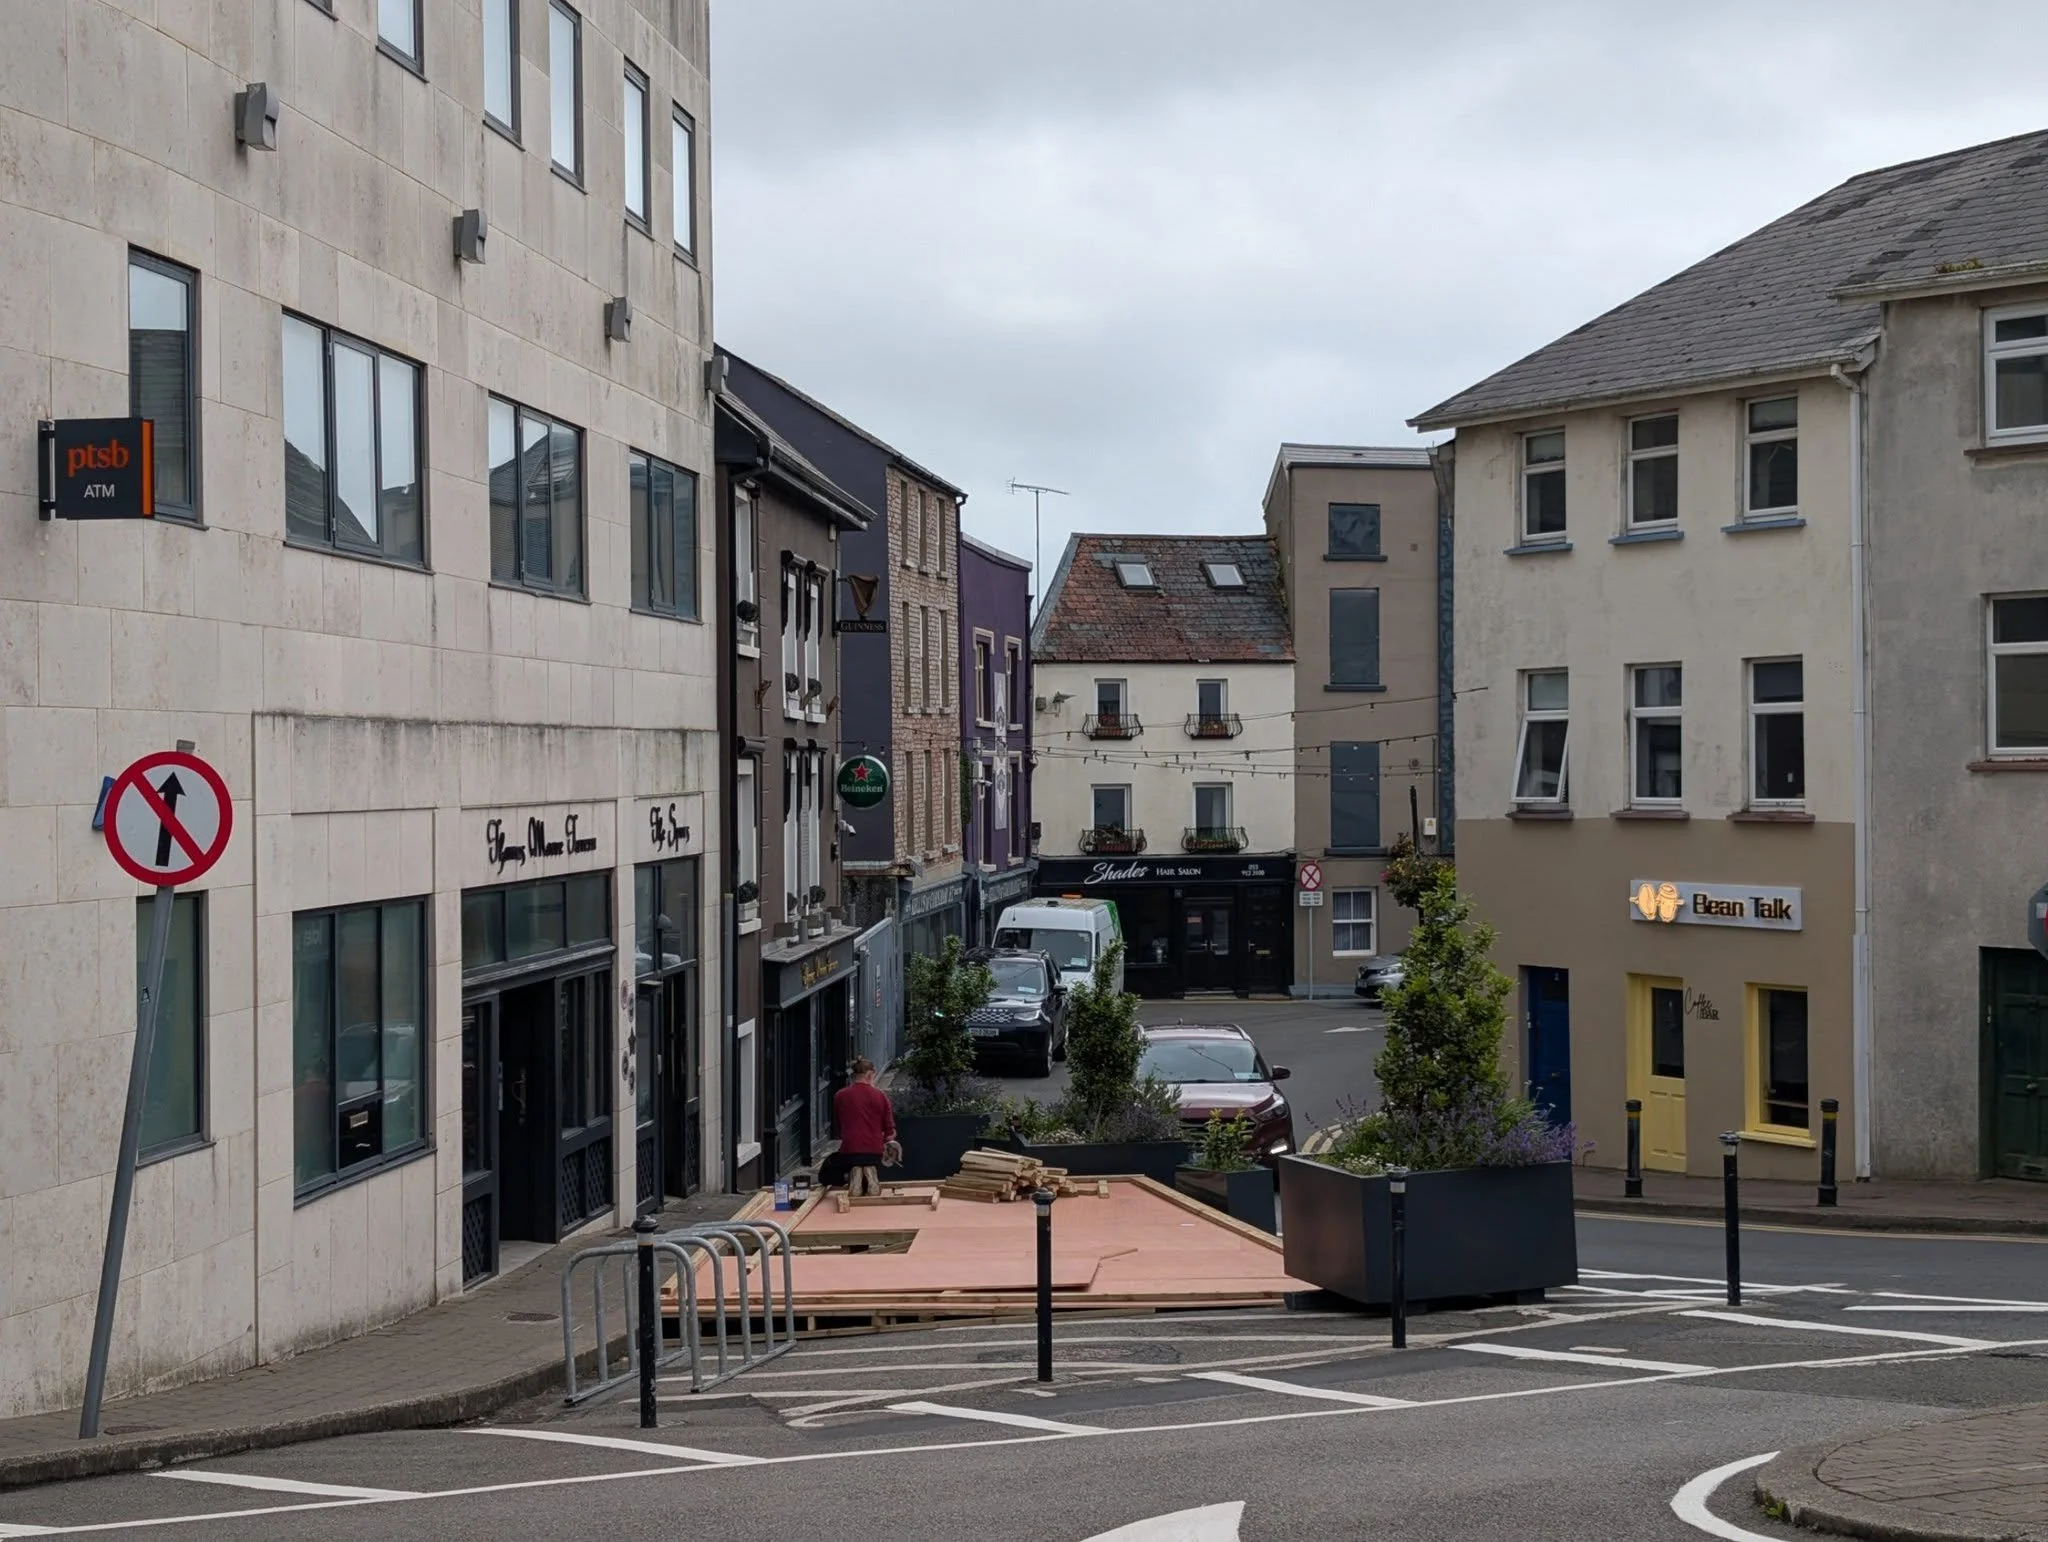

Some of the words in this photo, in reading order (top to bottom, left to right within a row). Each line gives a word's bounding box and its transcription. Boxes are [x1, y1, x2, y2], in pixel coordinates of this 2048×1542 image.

[67, 438, 129, 478] ptsb
[84, 484, 115, 498] ATM
[840, 621, 884, 632] GUINNESS
[840, 783, 884, 794] Heineken
[1084, 861, 1149, 885] Shades
[1156, 867, 1176, 876] HAIR
[1178, 867, 1201, 876] SALON
[1692, 893, 1744, 918] Bean
[1749, 896, 1792, 920] Talk
